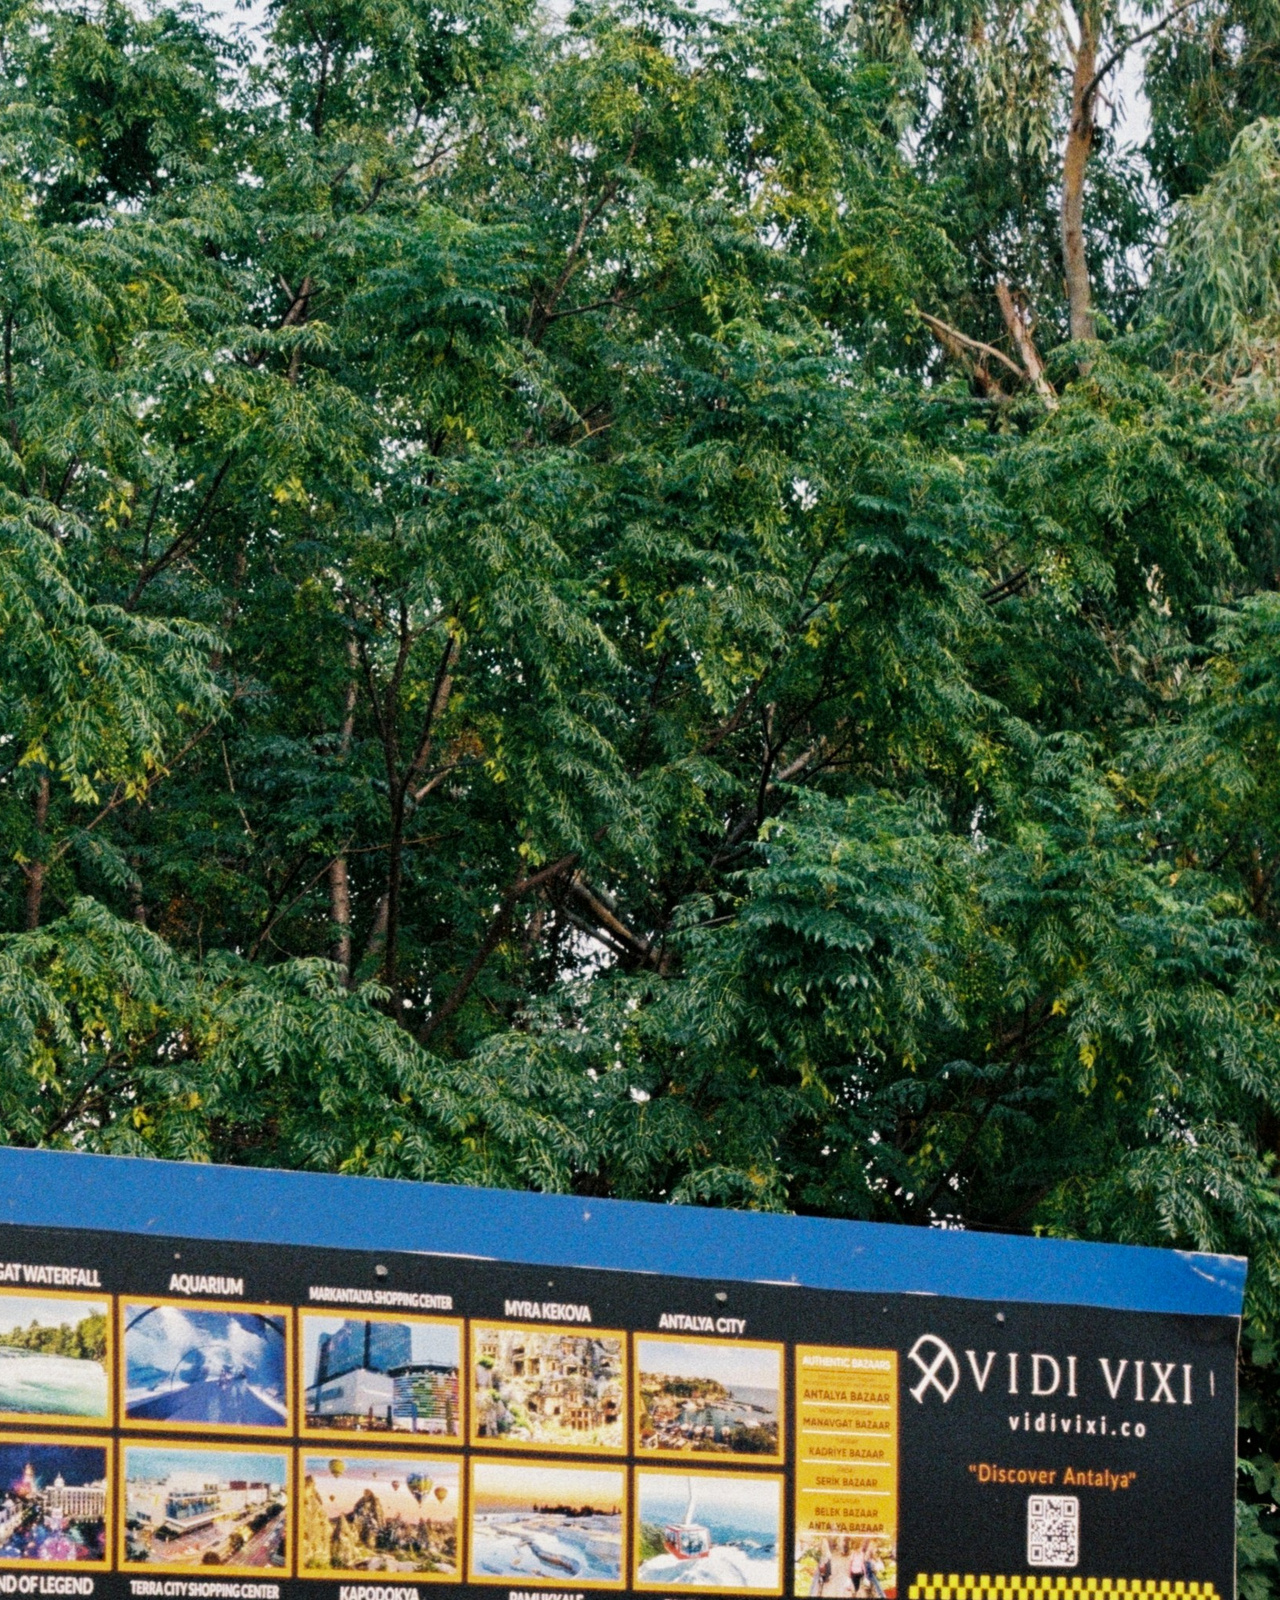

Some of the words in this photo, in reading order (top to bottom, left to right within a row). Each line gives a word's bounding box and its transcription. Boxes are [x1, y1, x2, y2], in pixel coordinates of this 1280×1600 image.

[22, 1264, 101, 1287] WATERFALL
[169, 1273, 243, 1295] AQUARIUM
[374, 1290, 419, 1307] SHOPPING
[419, 1294, 453, 1310] CENTER
[504, 1299, 540, 1318] MYRA
[542, 1303, 591, 1322] KEKOVA
[658, 1312, 714, 1332] ANTALYA
[715, 1317, 746, 1334] CITY
[965, 1350, 1077, 1397] VIDI
[1098, 1357, 1192, 1404] VIXI
[803, 1388, 847, 1401] ANTALYA
[850, 1391, 890, 1403] BAZAAR
[802, 1417, 852, 1429] MANAVGAT
[855, 1419, 890, 1430] BAZAAR
[1008, 1411, 1146, 1438] vidivixi.co
[849, 1448, 885, 1459] BAZAAR
[842, 1477, 878, 1488] BAZAAR
[815, 1507, 840, 1517] BELEK
[842, 1508, 878, 1518] BAZAAR
[849, 1523, 884, 1532] BAZAAR
[19, 1575, 38, 1594] OF
[39, 1576, 94, 1595] LEGEND
[130, 1580, 164, 1596] TERRA
[164, 1581, 188, 1597] CITY
[188, 1583, 241, 1598] SHOPPING
[241, 1584, 280, 1599] CENTER
